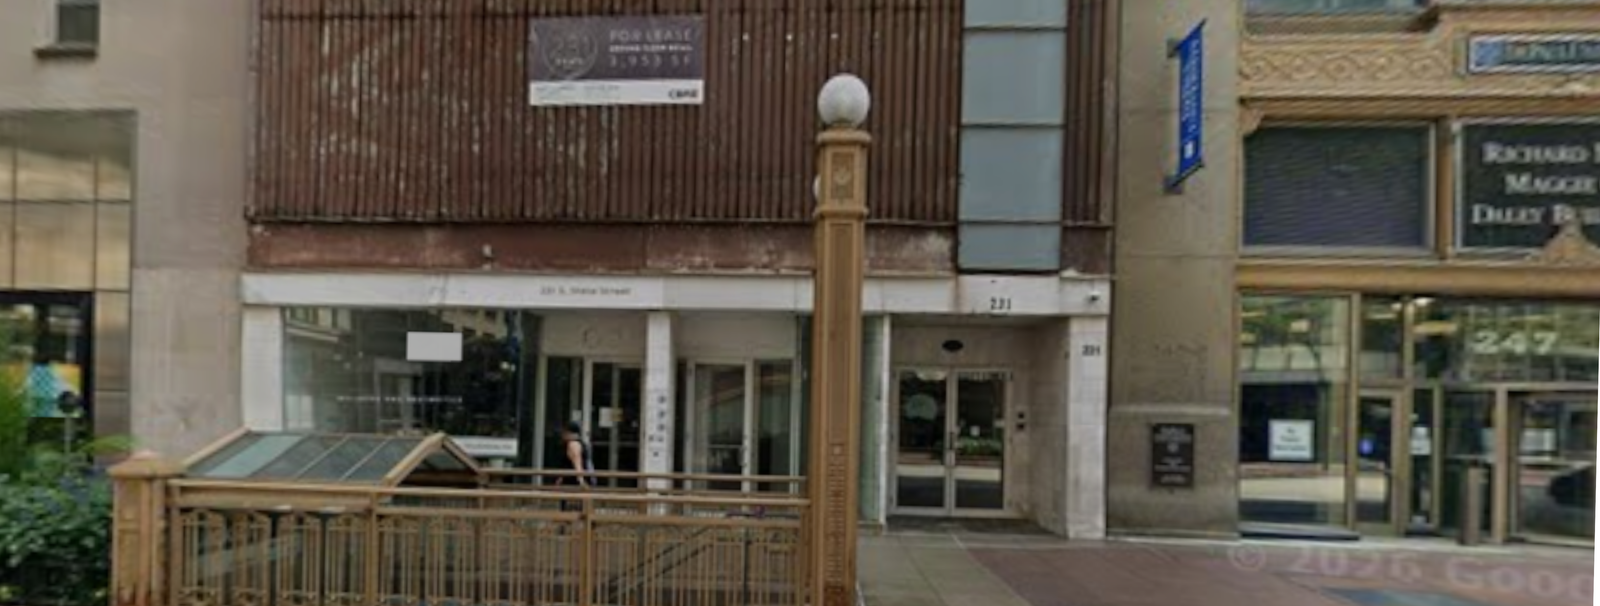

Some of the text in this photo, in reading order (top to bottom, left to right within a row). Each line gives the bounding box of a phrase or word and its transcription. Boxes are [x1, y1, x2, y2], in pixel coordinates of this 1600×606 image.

[609, 28, 691, 41] FOR LEASE
[1474, 331, 1558, 355] 247
